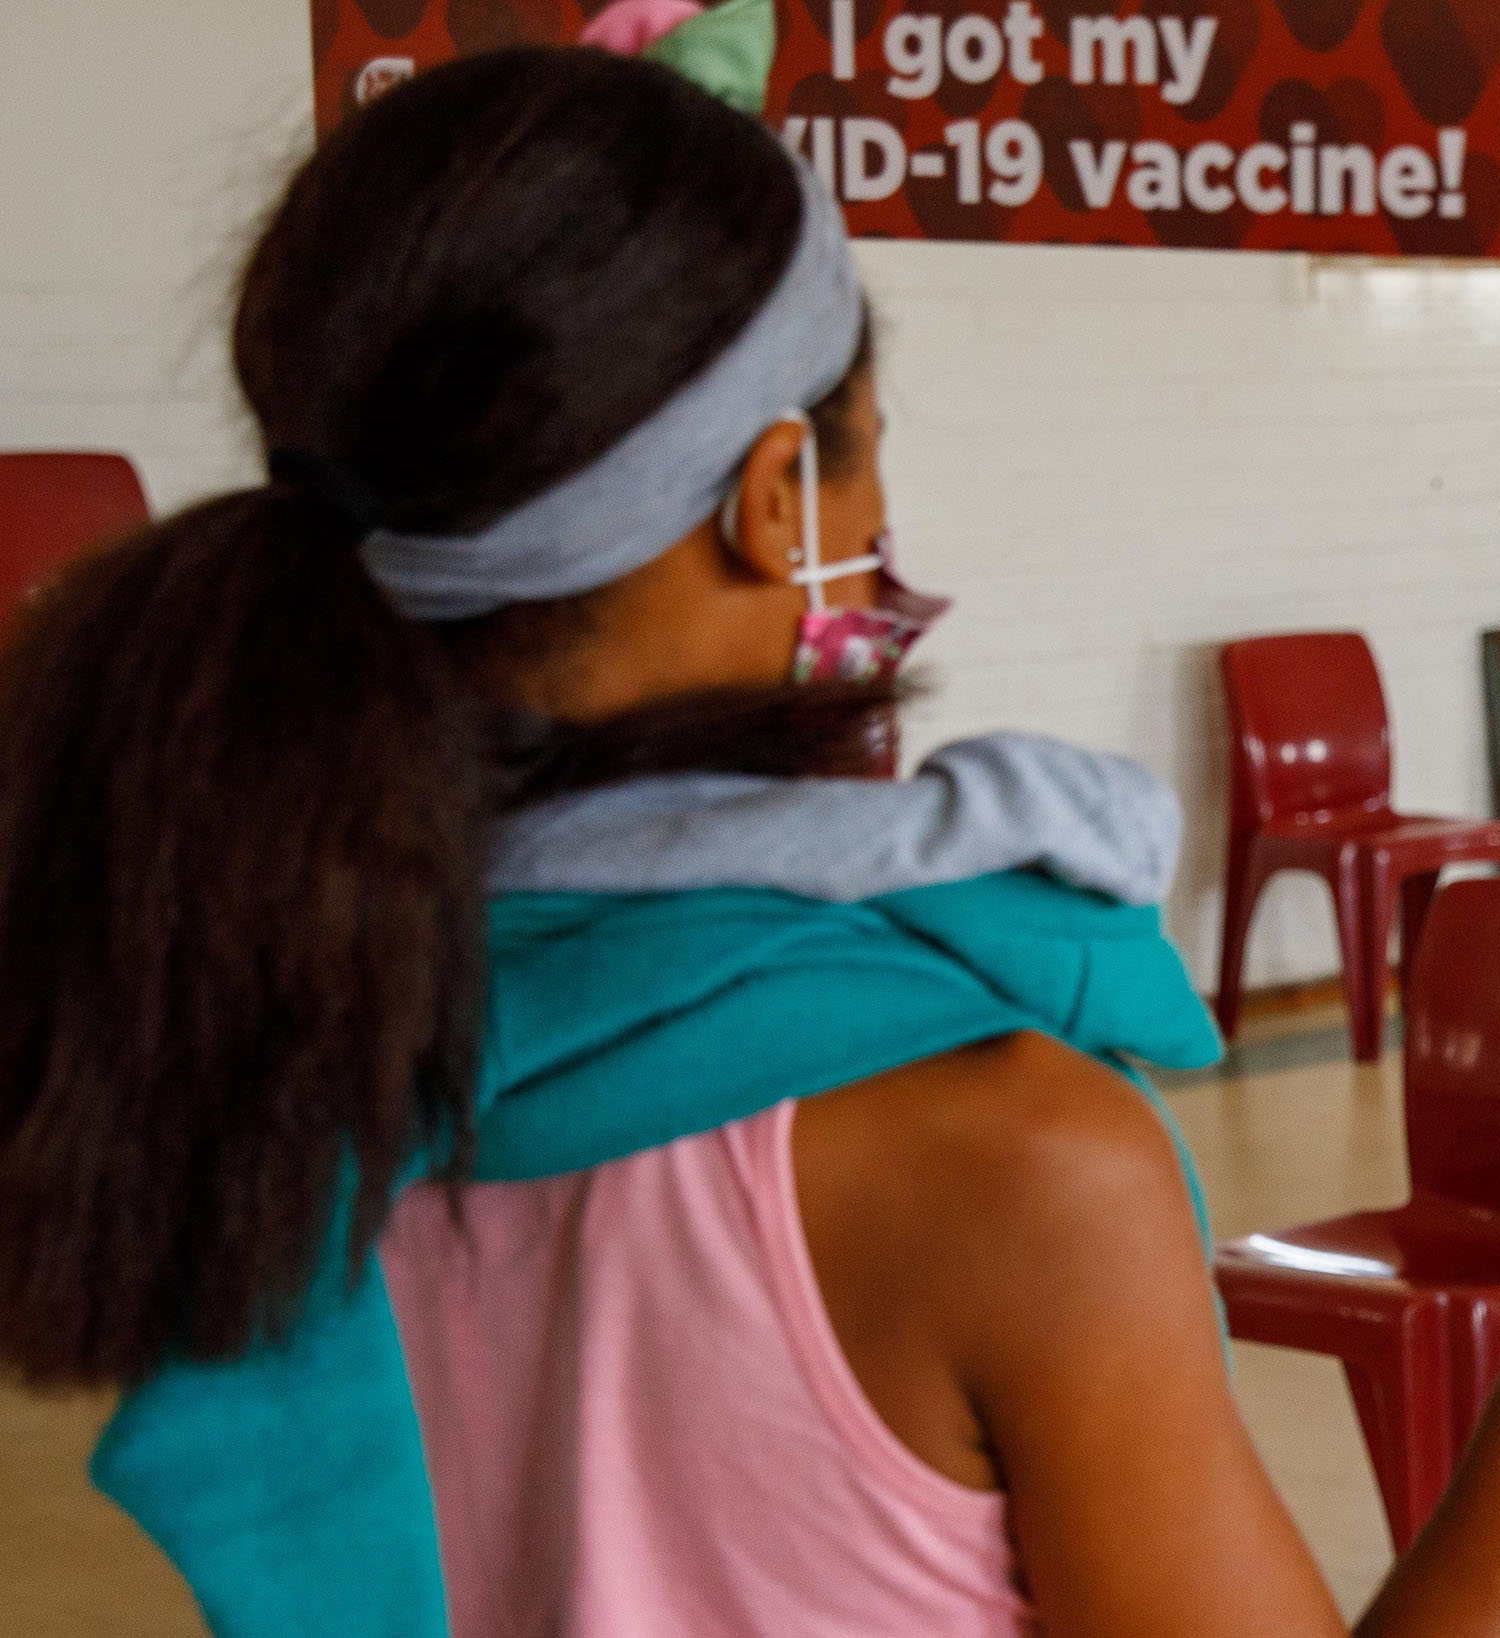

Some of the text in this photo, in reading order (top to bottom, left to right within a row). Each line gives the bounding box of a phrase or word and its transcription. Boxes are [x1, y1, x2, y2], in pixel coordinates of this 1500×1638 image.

[831, 0, 1218, 105] I got my
[1068, 121, 1467, 219] vaccine!
